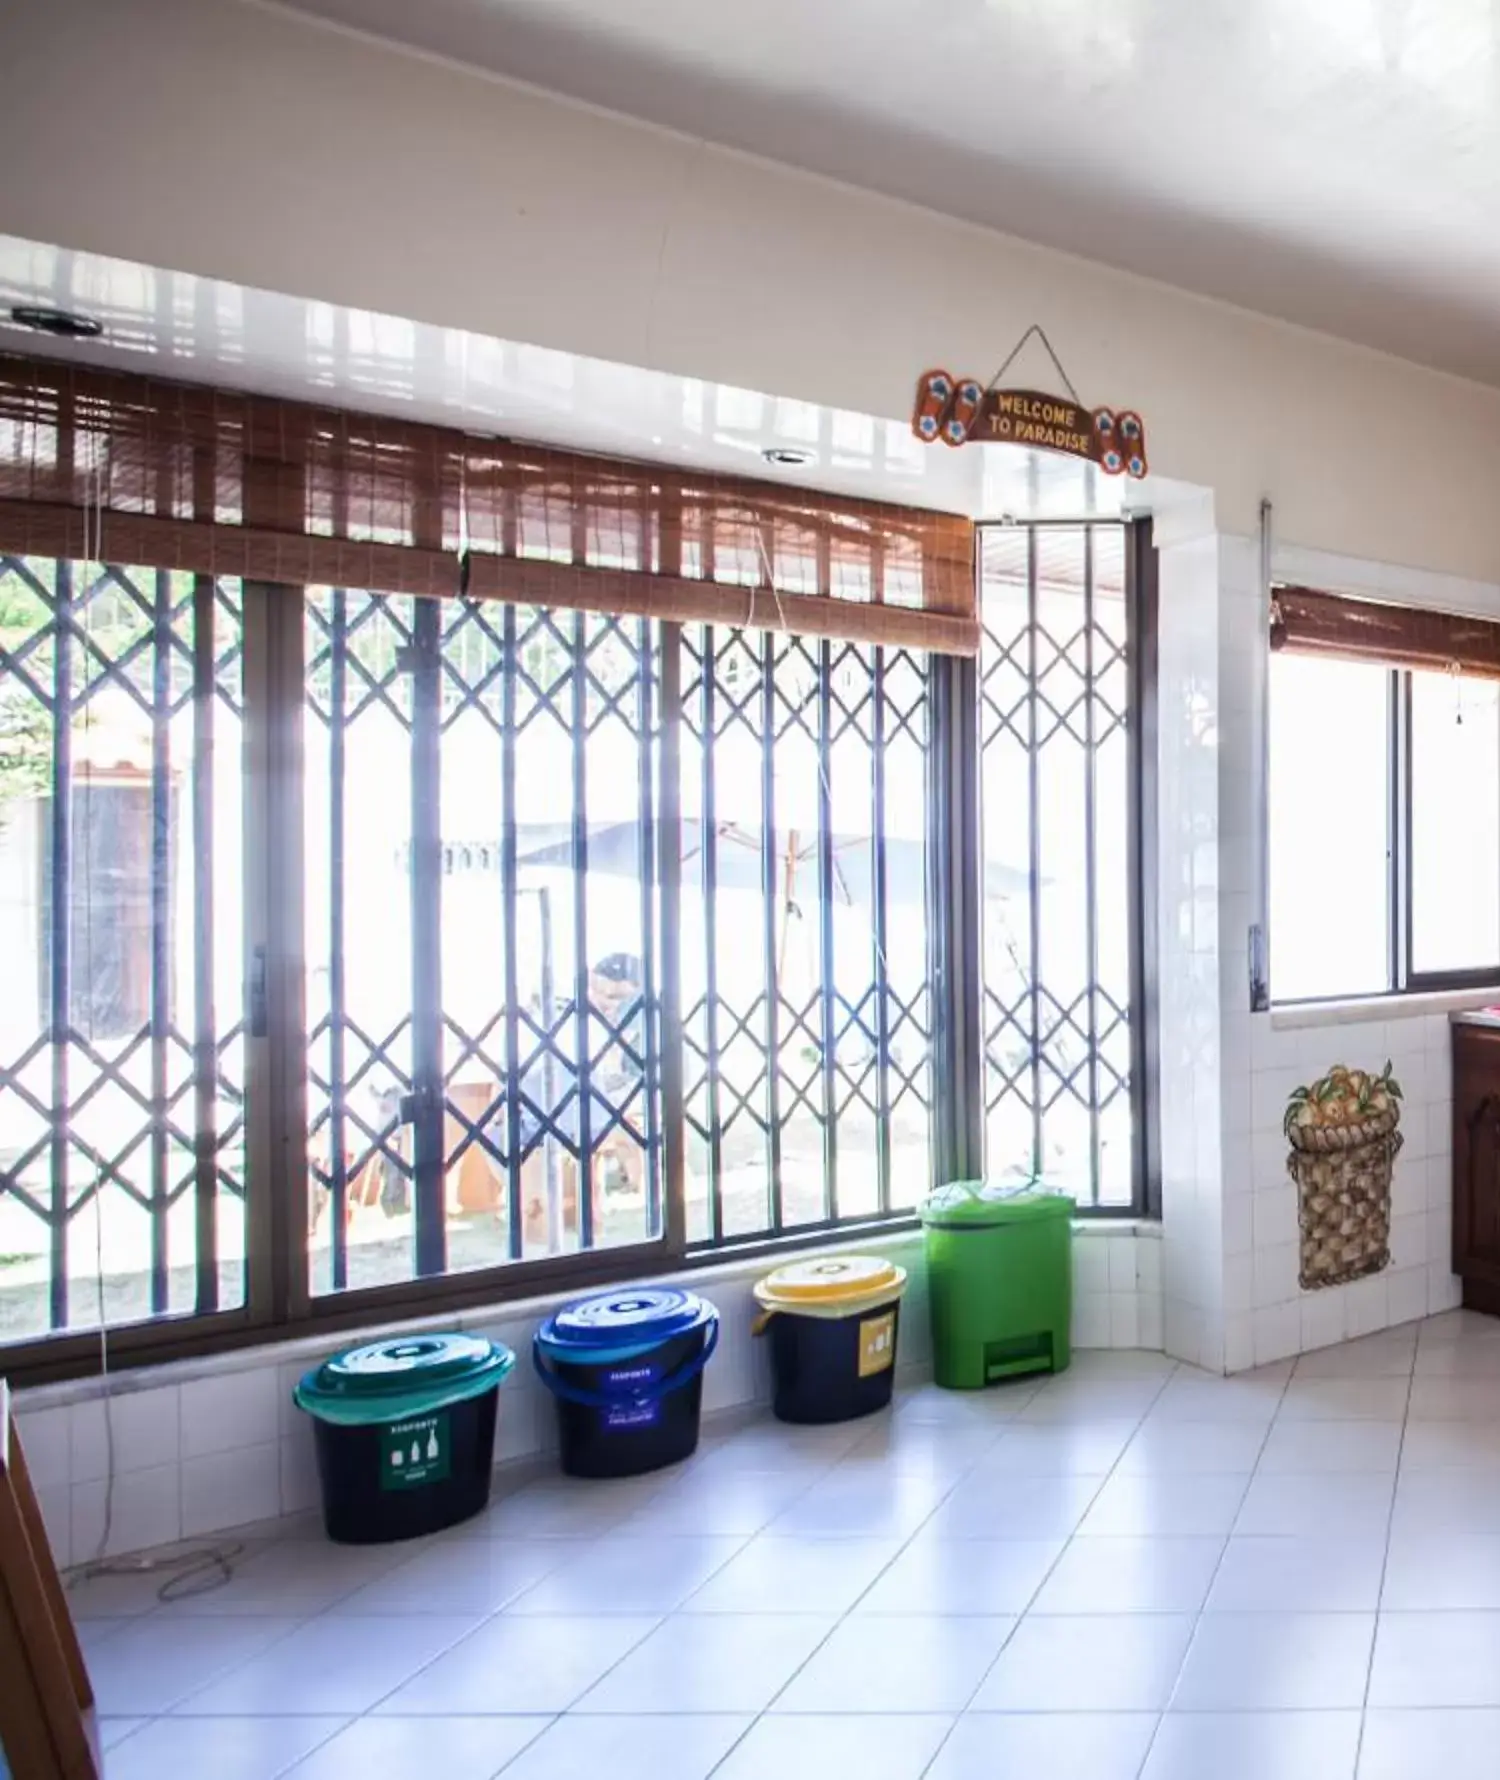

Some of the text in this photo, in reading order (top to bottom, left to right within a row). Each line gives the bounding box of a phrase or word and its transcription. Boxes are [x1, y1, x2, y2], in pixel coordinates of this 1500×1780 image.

[1000, 395, 1076, 427] WELCOME
[989, 415, 1090, 452] TO PARADISE
